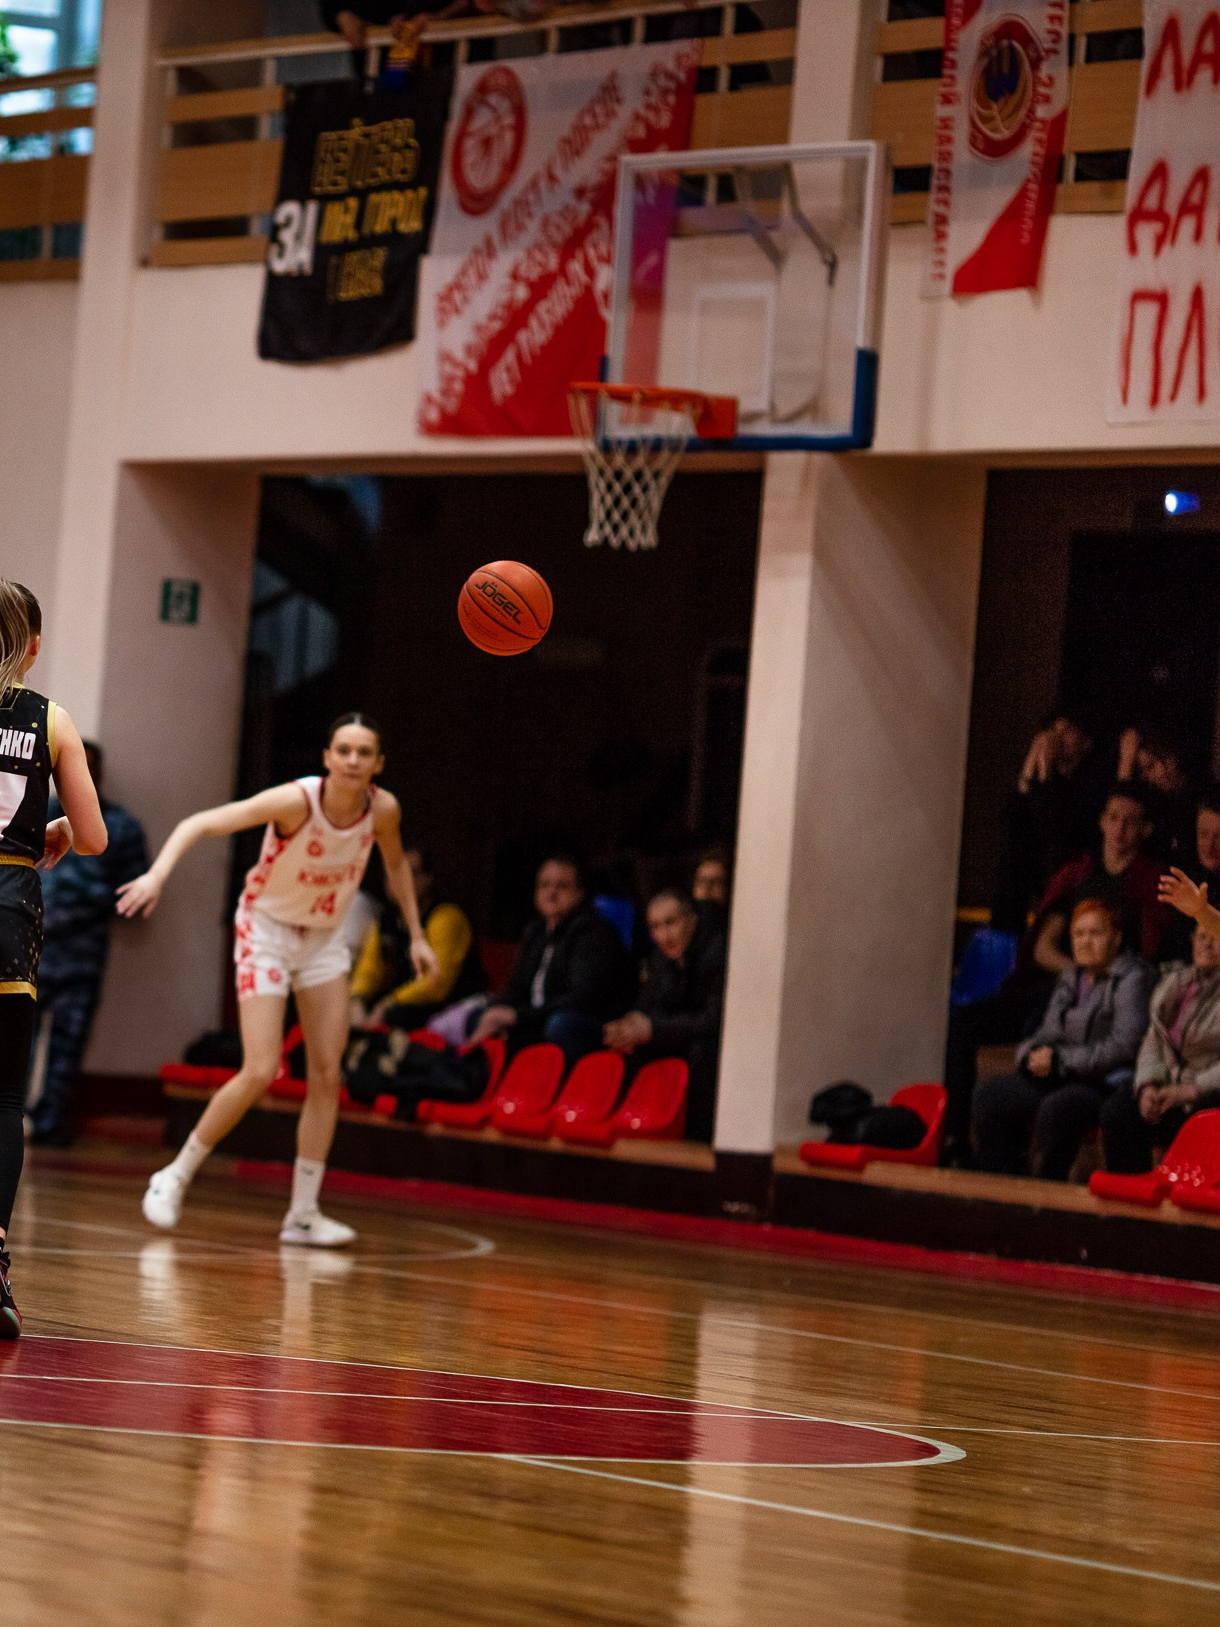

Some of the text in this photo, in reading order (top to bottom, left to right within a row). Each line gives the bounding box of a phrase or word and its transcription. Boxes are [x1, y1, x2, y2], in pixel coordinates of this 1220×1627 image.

[1126, 157, 1220, 258] ДА
[1120, 281, 1220, 410] ПЛ
[474, 580, 522, 625] JÖGEL
